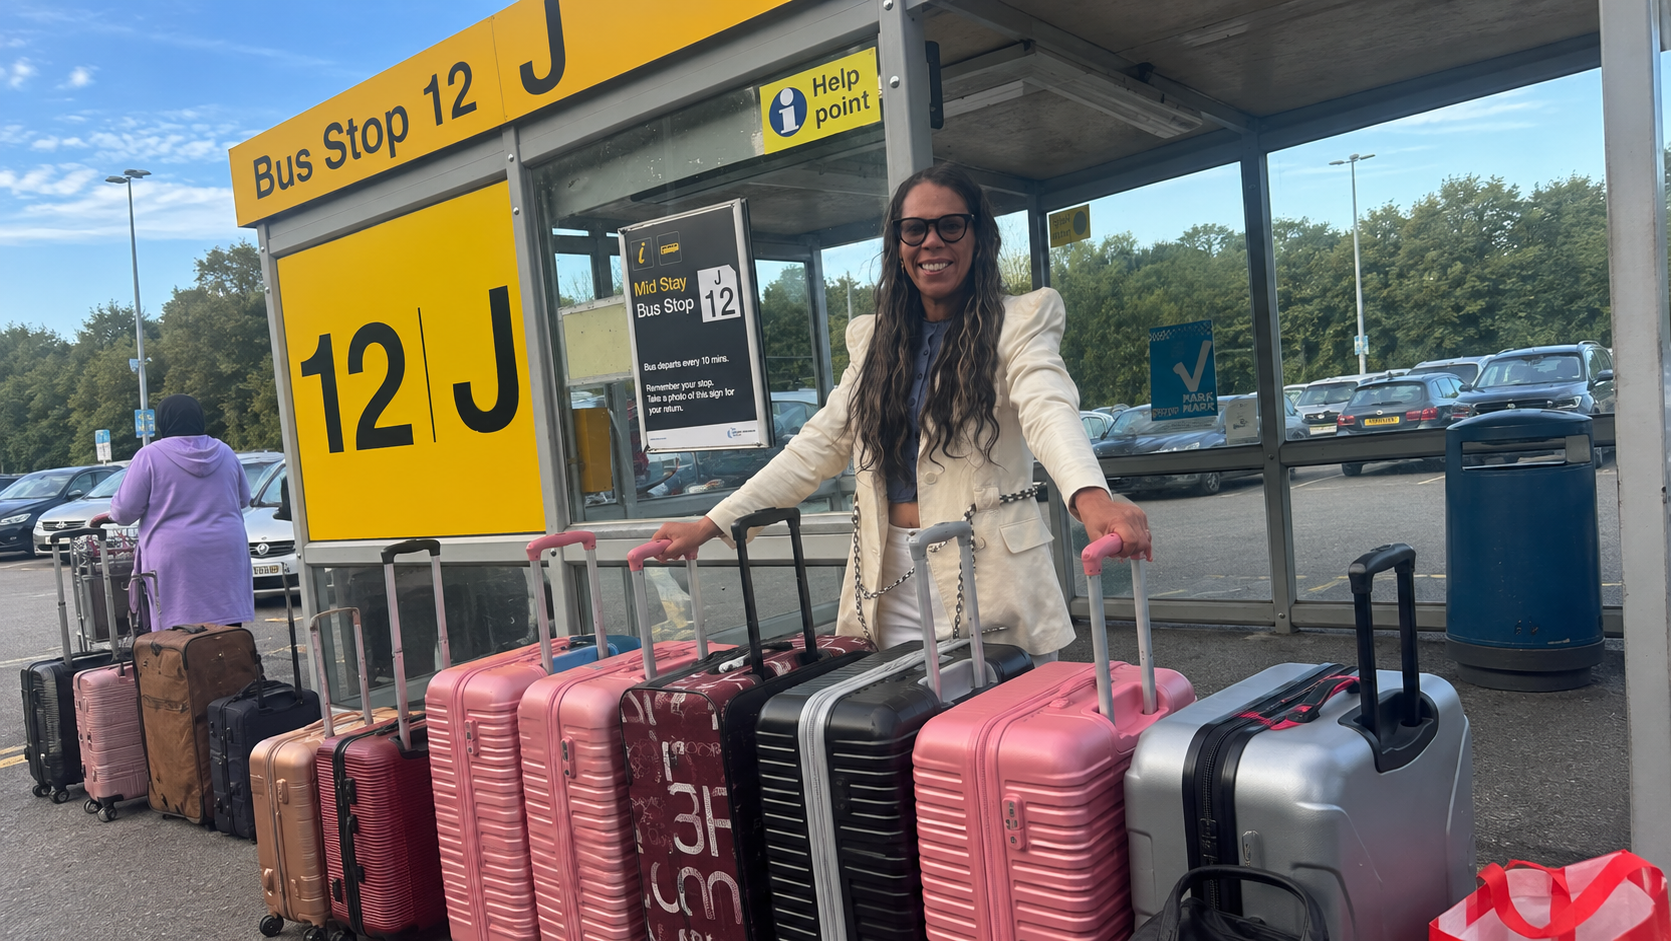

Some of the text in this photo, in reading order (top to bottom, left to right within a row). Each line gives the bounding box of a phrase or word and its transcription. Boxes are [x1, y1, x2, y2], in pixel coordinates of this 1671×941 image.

[812, 67, 860, 98] Help
[253, 0, 566, 199] Bus Stop 12 J
[815, 90, 871, 130] point
[633, 276, 687, 297] Mid Stay
[714, 270, 721, 285] J
[636, 297, 695, 318] Bus Stop
[705, 287, 736, 317] 12
[300, 285, 519, 453] 12 J
[644, 363, 657, 371] Bus
[657, 361, 681, 370] departs
[682, 359, 700, 367] every
[646, 383, 680, 392] Remember
[681, 381, 696, 390] your
[668, 392, 686, 403] photo
[709, 389, 723, 399] sign
[725, 388, 735, 396] for
[648, 406, 662, 416] your
